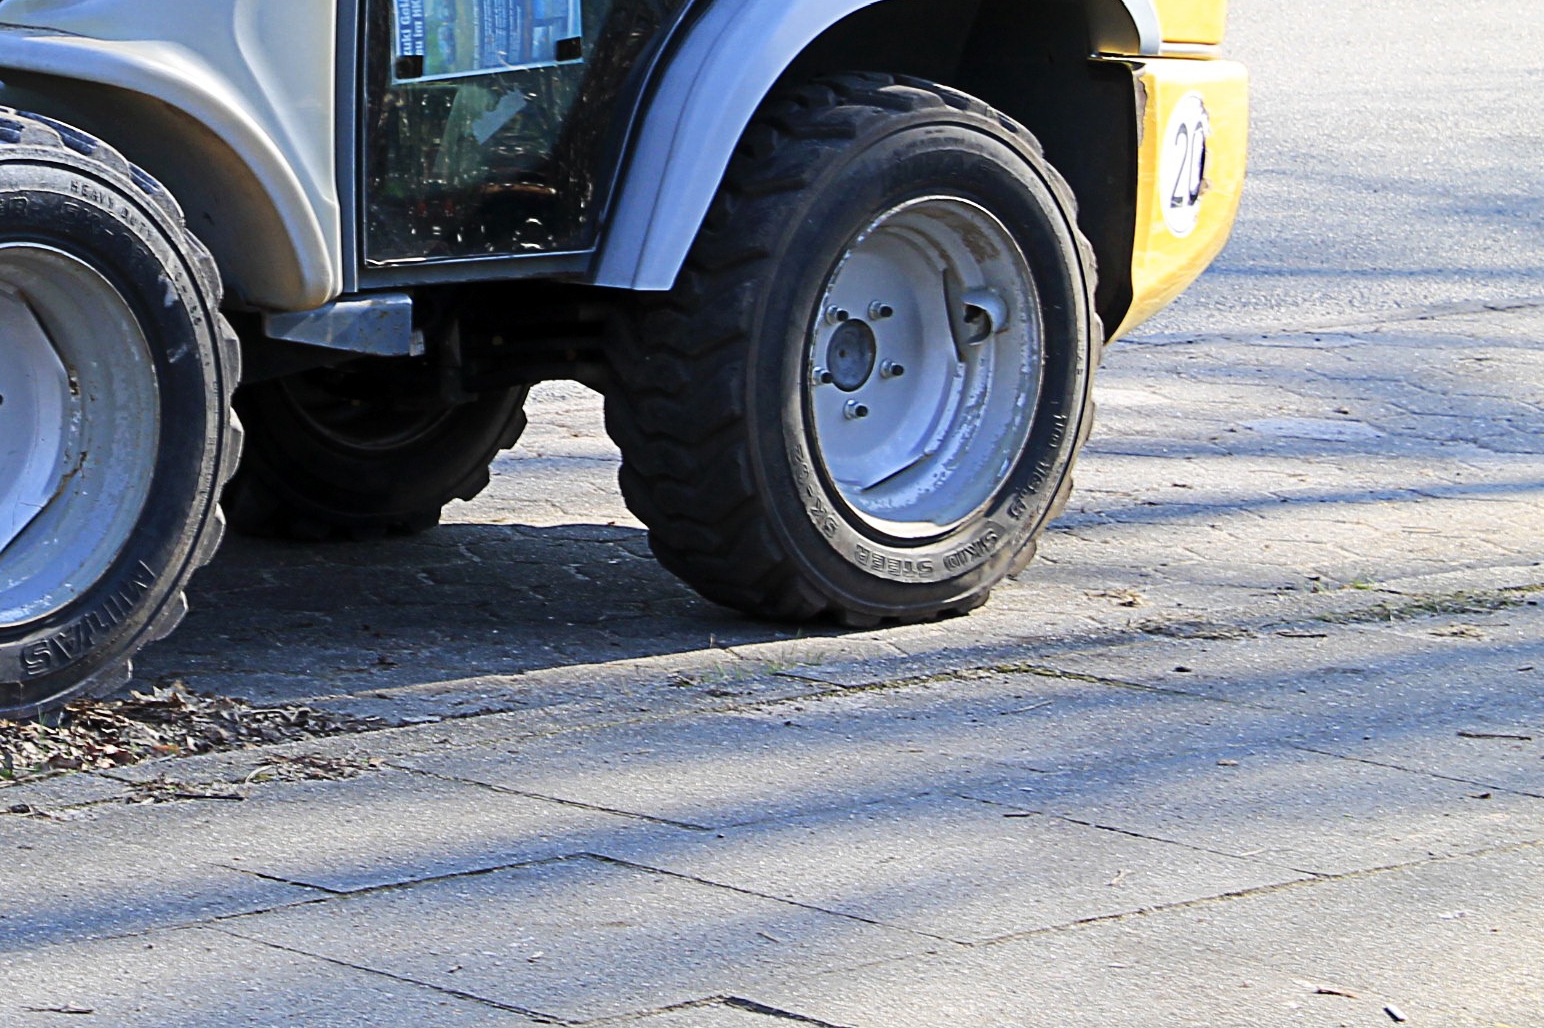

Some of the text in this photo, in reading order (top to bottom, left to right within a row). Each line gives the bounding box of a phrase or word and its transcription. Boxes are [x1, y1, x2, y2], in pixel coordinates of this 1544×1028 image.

[1170, 120, 1206, 208] 20
[855, 544, 933, 581] STEER
[943, 528, 998, 572] SKID
